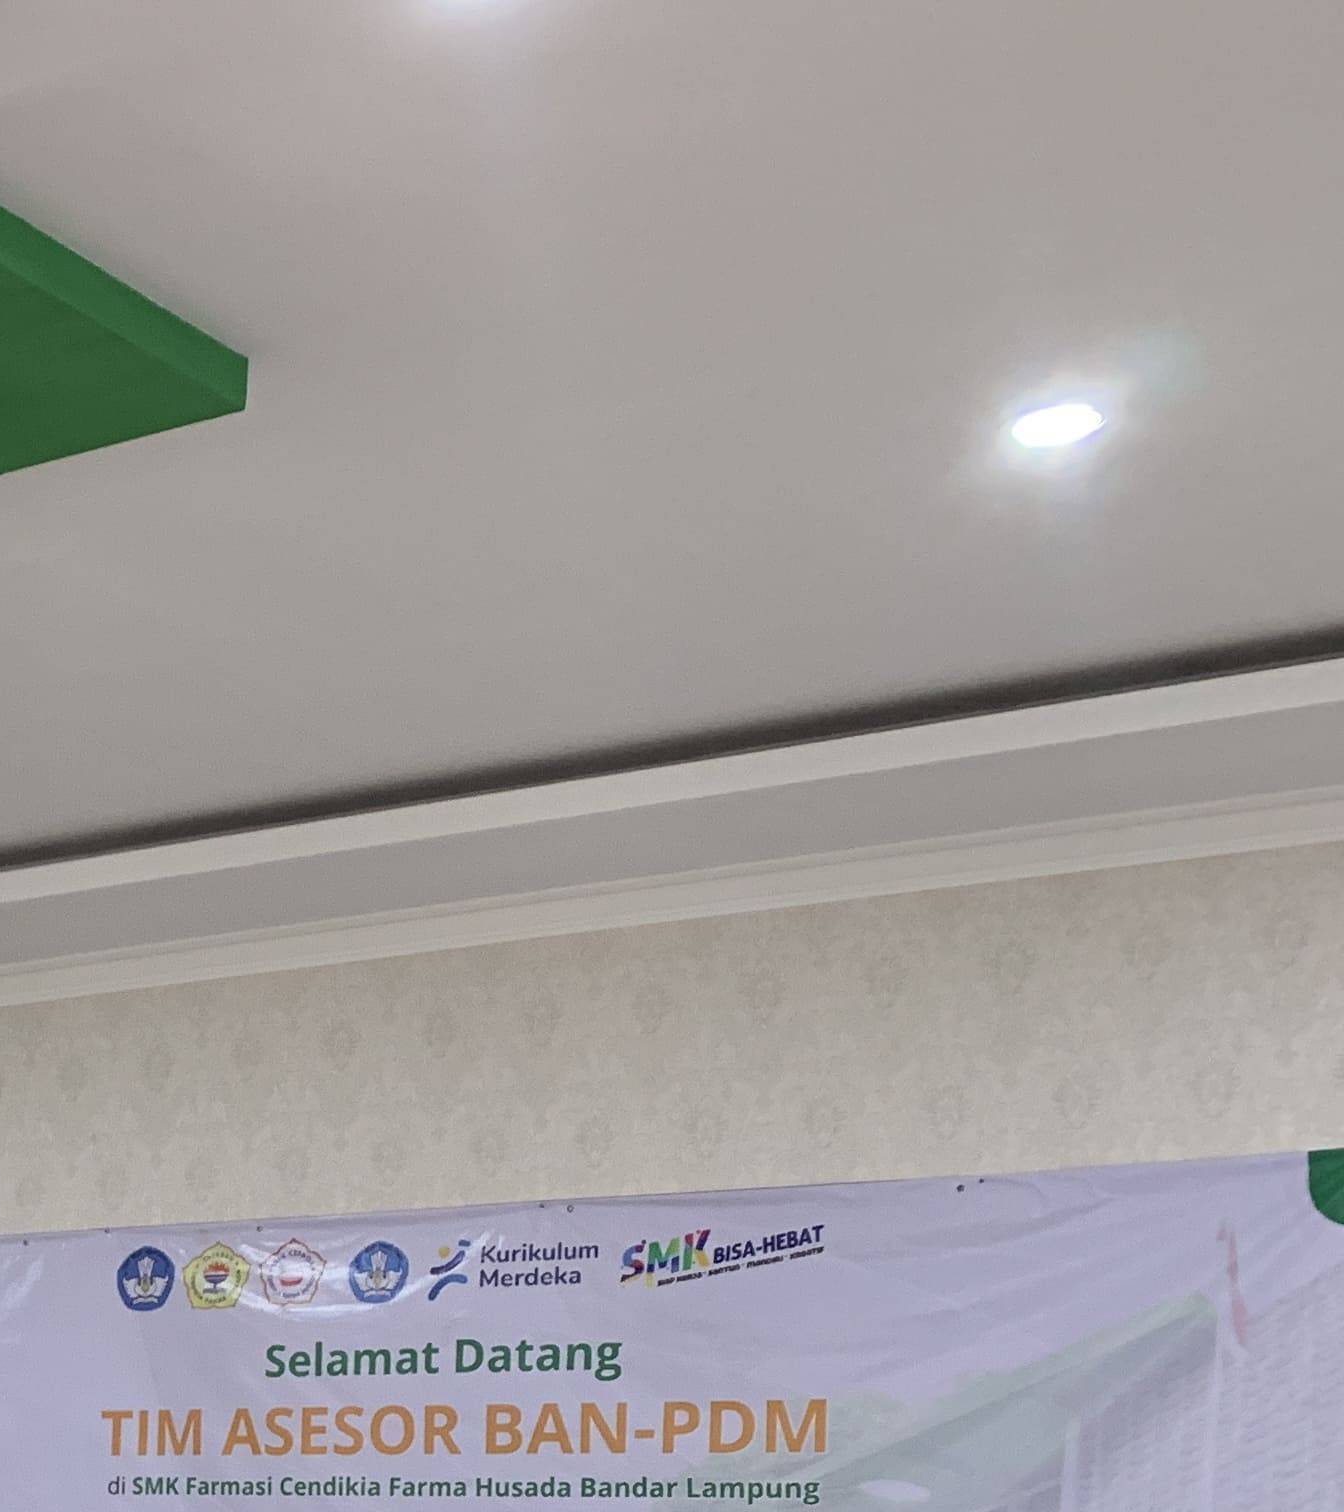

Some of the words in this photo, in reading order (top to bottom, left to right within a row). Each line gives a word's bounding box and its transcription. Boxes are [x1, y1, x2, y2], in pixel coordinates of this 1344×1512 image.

[480, 1242, 599, 1263] Kurikulum
[620, 1229, 711, 1287] SMK
[713, 1225, 824, 1264] BISA-HEBAT
[478, 1267, 582, 1288] Merdeka
[265, 1341, 440, 1378] Selamat
[455, 1339, 623, 1381] Datang
[101, 1408, 203, 1456] TIM
[221, 1404, 462, 1456] ASESOR
[485, 1398, 827, 1455] BAN-PDM
[107, 1476, 126, 1496] di
[132, 1476, 179, 1496] SMK
[186, 1476, 273, 1497] Farmasi
[280, 1476, 381, 1497] Cendikia
[389, 1477, 467, 1498] Farma
[476, 1476, 572, 1499] Husada
[580, 1476, 678, 1499] Bandar
[686, 1477, 820, 1506] Lampung
